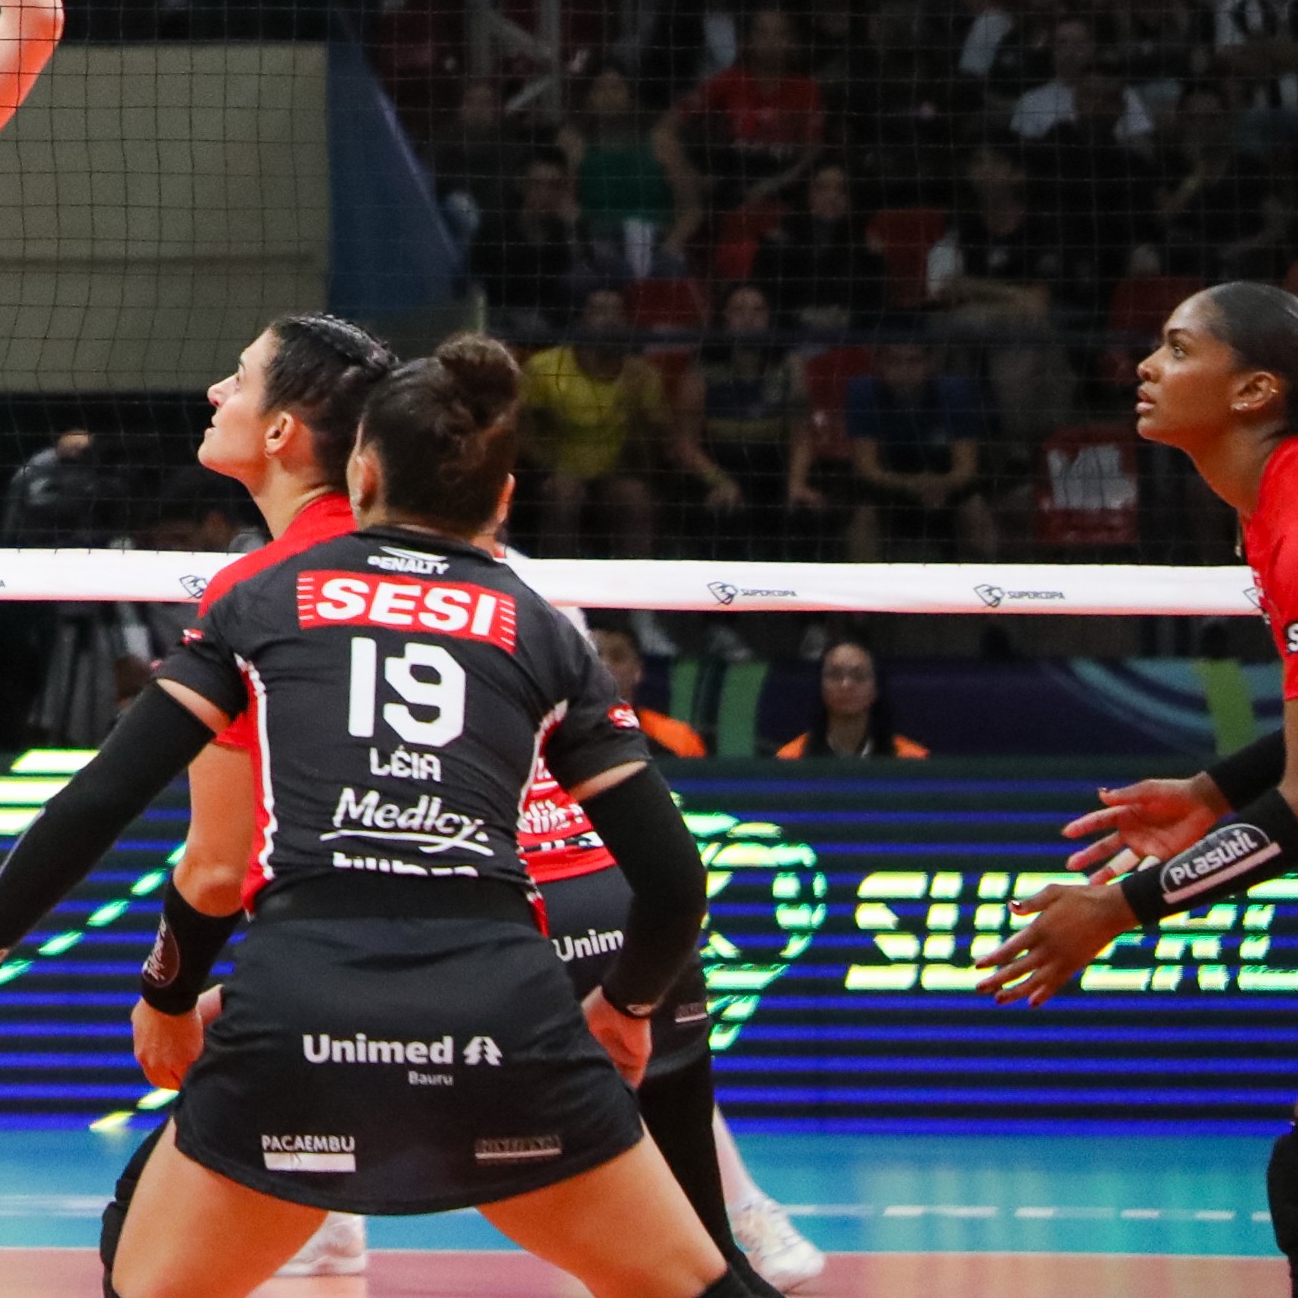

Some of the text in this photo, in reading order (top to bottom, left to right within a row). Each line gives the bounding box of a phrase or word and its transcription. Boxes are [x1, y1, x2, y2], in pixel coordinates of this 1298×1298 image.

[316, 578, 497, 637] SESI
[348, 636, 466, 747] 19
[369, 745, 442, 782] LÉIA
[553, 929, 624, 962] Unim
[303, 1033, 453, 1066] Unimed
[408, 1070, 454, 1087] Bauru
[261, 1133, 356, 1154] PACAEMBU
